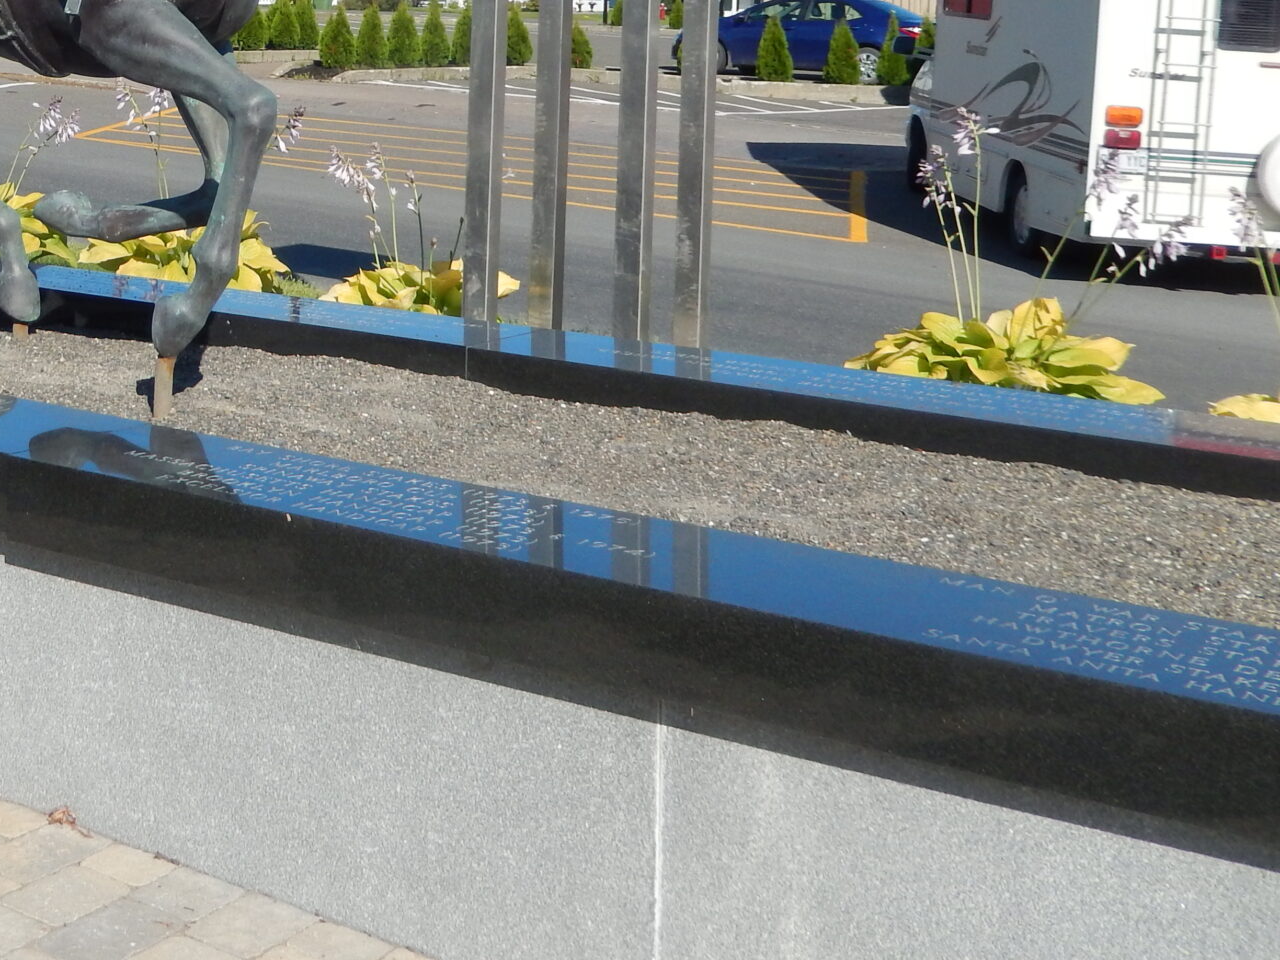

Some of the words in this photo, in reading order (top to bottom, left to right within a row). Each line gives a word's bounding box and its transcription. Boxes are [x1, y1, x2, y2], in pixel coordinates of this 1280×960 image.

[124, 450, 312, 491] MASSACHUSETTS
[319, 488, 453, 518] HANDICAP
[227, 445, 272, 456] BAY
[277, 454, 352, 473] SHORE
[362, 469, 453, 490] STAKES
[239, 463, 354, 488] SPINAWAY
[360, 486, 454, 509] STAKES
[270, 461, 396, 488] MARLBORO
[406, 486, 458, 501] CUP
[154, 473, 283, 502] EXCELSIOR
[290, 501, 427, 532] HANDICAP
[177, 469, 302, 497] BROOKLYN
[308, 495, 444, 526] HANDICAP
[939, 577, 1016, 595] MAN
[1093, 604, 1161, 623] WAR
[1030, 603, 1182, 637] MATRON
[972, 615, 1210, 667] HAWTHORNE
[1017, 611, 1176, 648] TRAVERS
[1021, 636, 1145, 666] DWYER
[921, 628, 1031, 657] SANTA
[1050, 655, 1161, 684] ANITA
